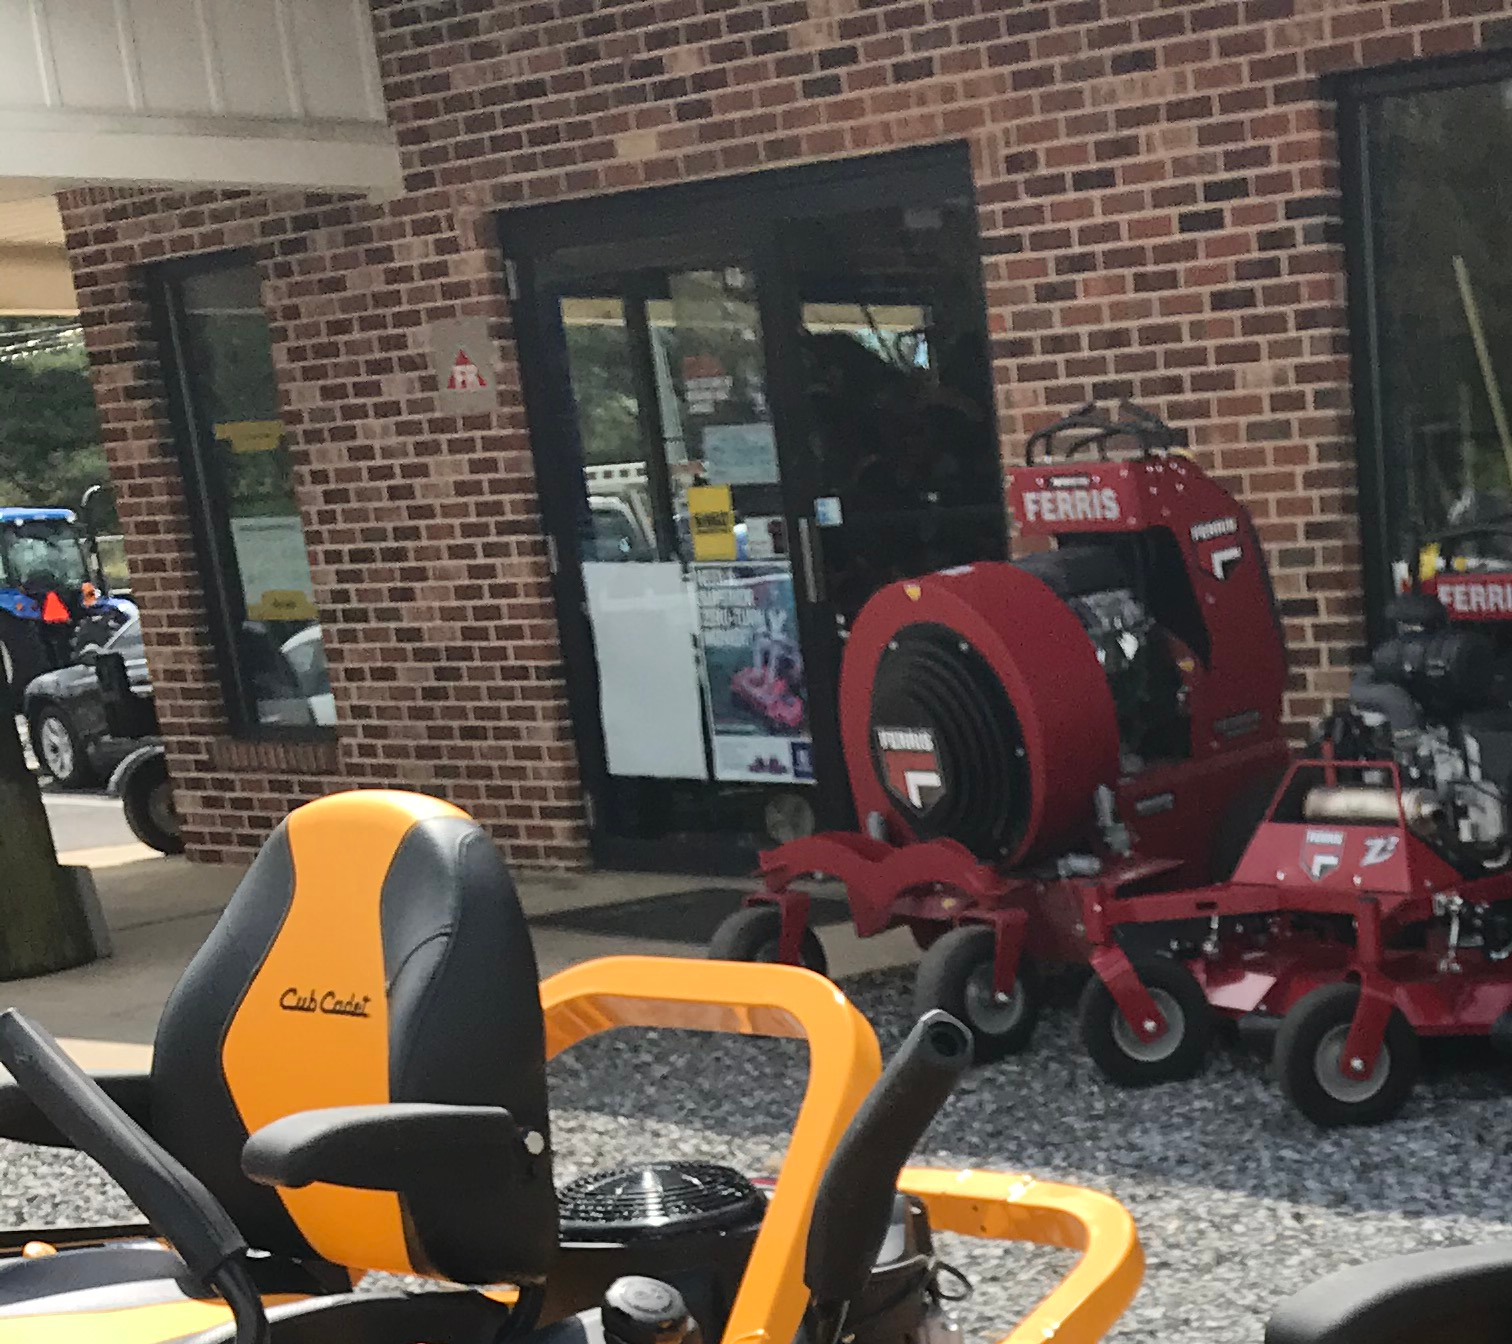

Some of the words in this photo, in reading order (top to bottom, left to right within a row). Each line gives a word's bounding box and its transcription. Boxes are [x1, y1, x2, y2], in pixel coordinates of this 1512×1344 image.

[1021, 487, 1121, 523] FERRIS
[279, 987, 318, 1013] Cub
[320, 990, 372, 1019] Cadet
